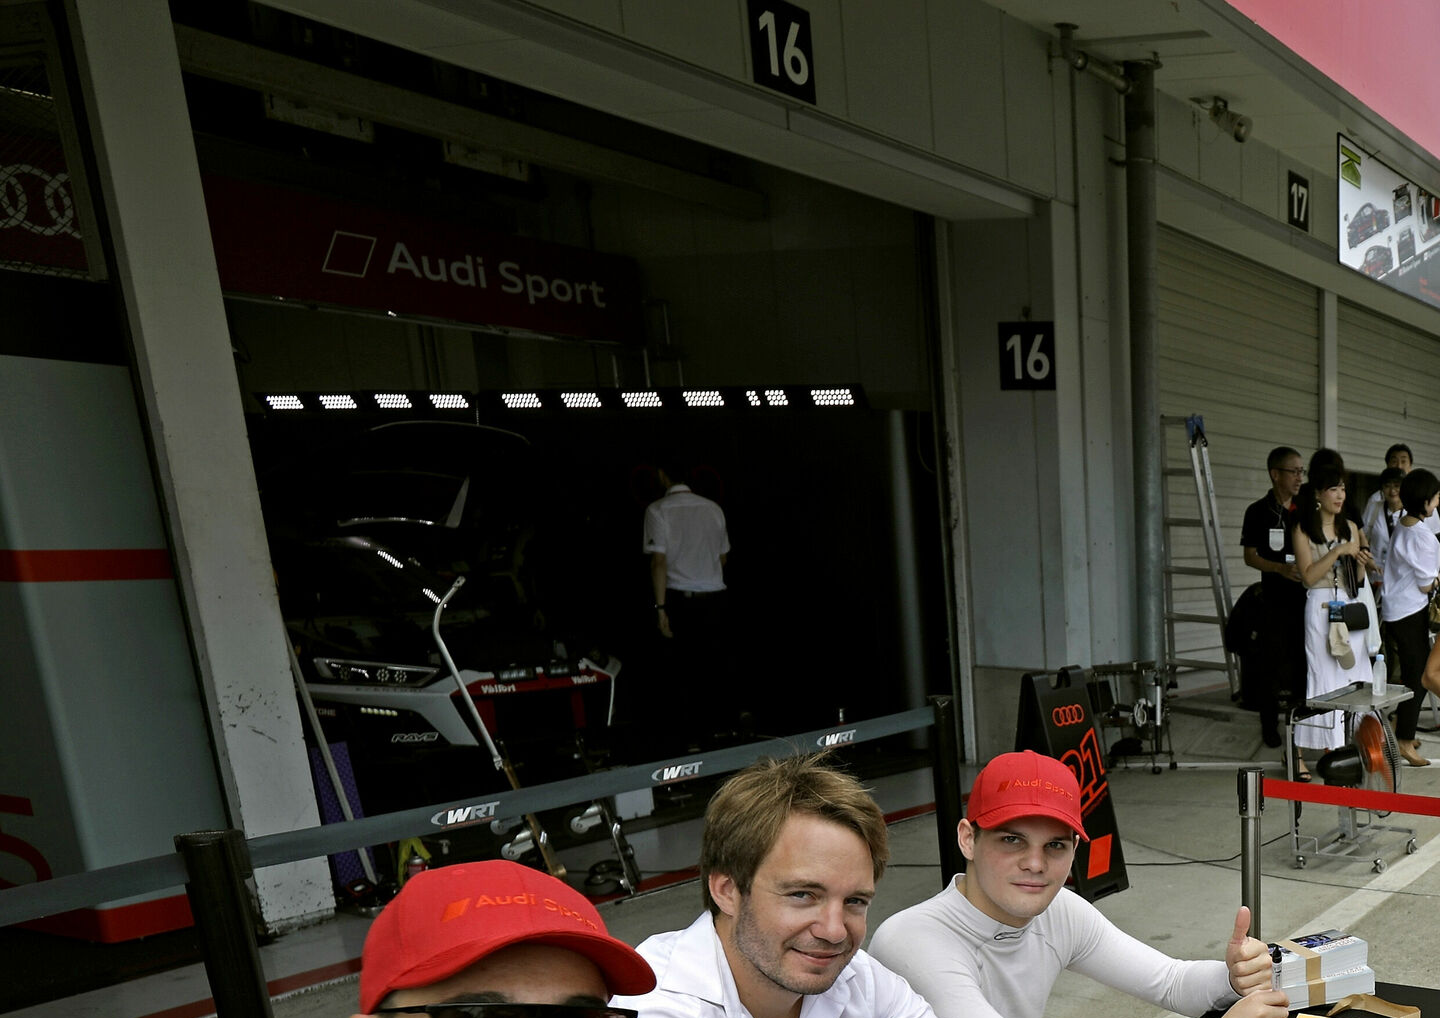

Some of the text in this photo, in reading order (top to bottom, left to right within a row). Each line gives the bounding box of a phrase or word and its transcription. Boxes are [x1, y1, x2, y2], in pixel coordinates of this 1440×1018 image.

[759, 10, 808, 85] 16
[1291, 183, 1308, 222] 17
[387, 241, 606, 308] Audi Sport
[1006, 334, 1050, 380] 16
[822, 730, 857, 747] WRT
[663, 761, 703, 782] WRT
[1013, 778, 1042, 788] Audi
[446, 801, 500, 825] WRT
[475, 892, 598, 932] Audi Sport
